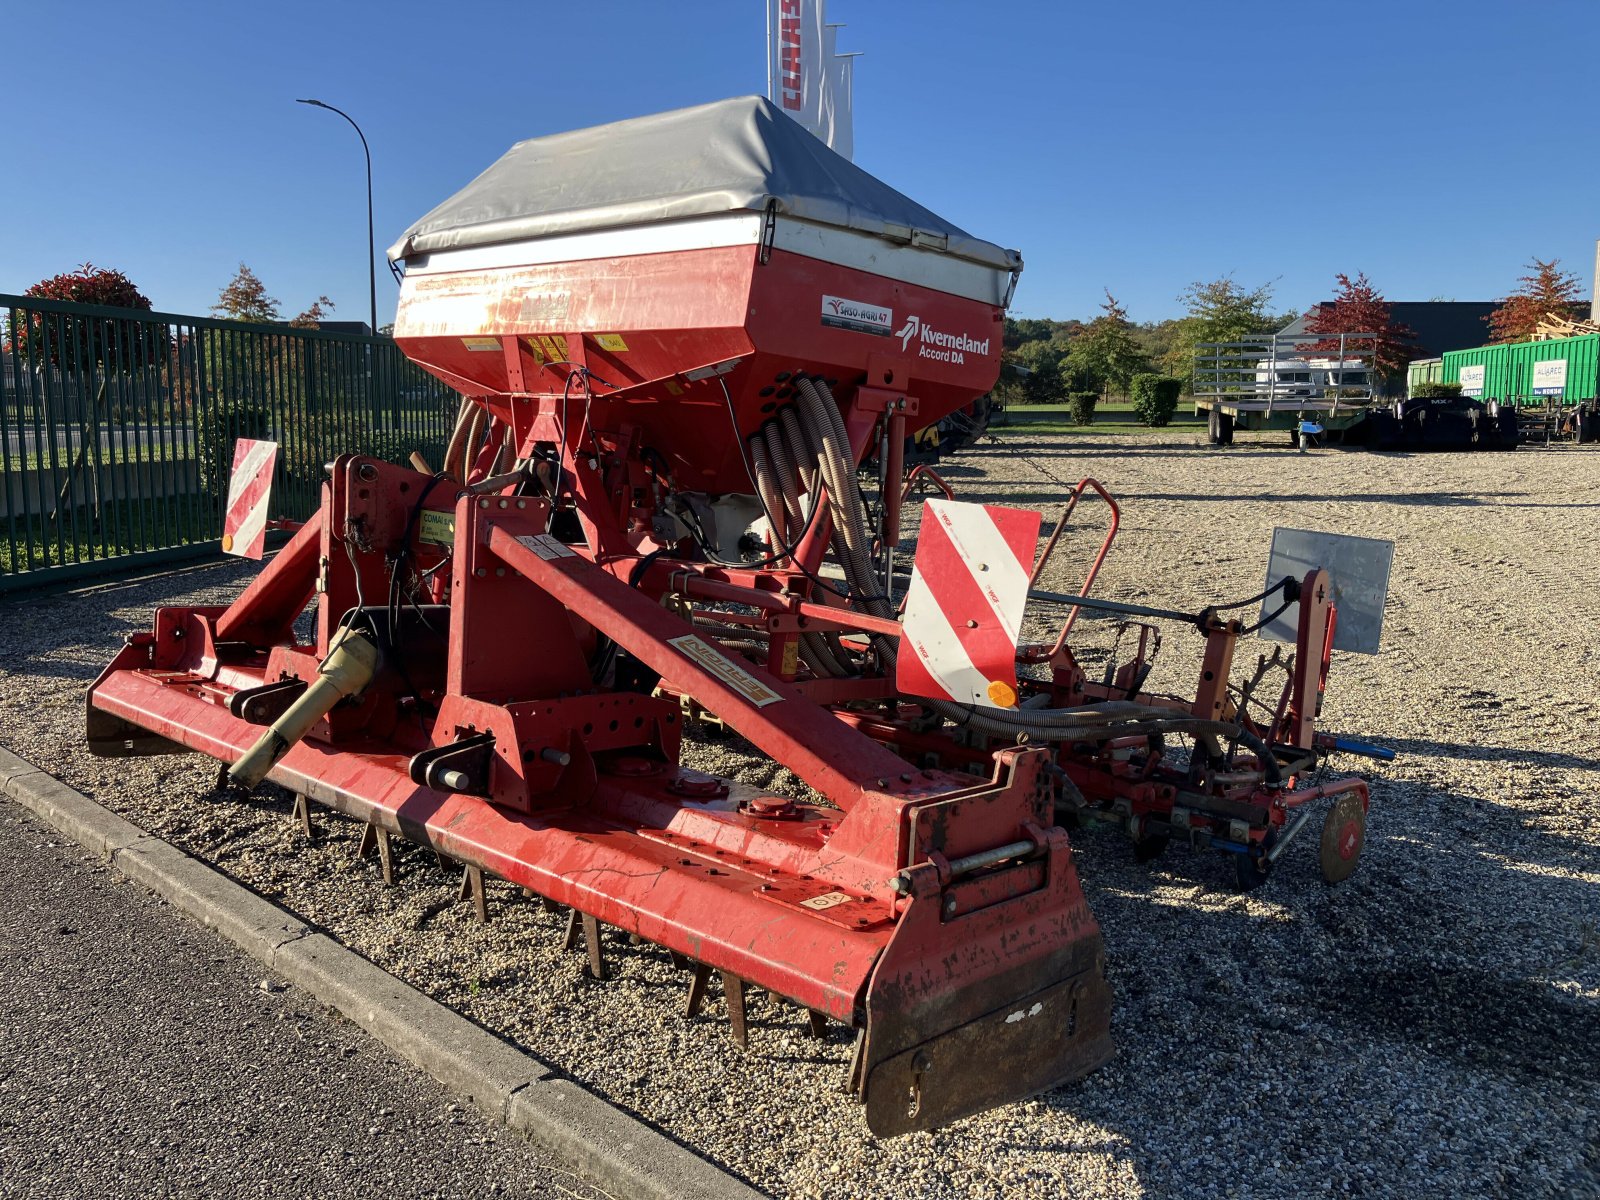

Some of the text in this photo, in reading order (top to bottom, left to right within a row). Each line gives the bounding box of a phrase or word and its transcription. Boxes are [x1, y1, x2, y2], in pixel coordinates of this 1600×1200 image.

[879, 312, 888, 323] 47
[920, 323, 989, 356] Kverneland
[918, 344, 965, 364] Accord DA
[941, 513, 953, 527] WGF
[988, 589, 1000, 605] WGF
[918, 645, 929, 660] WGF
